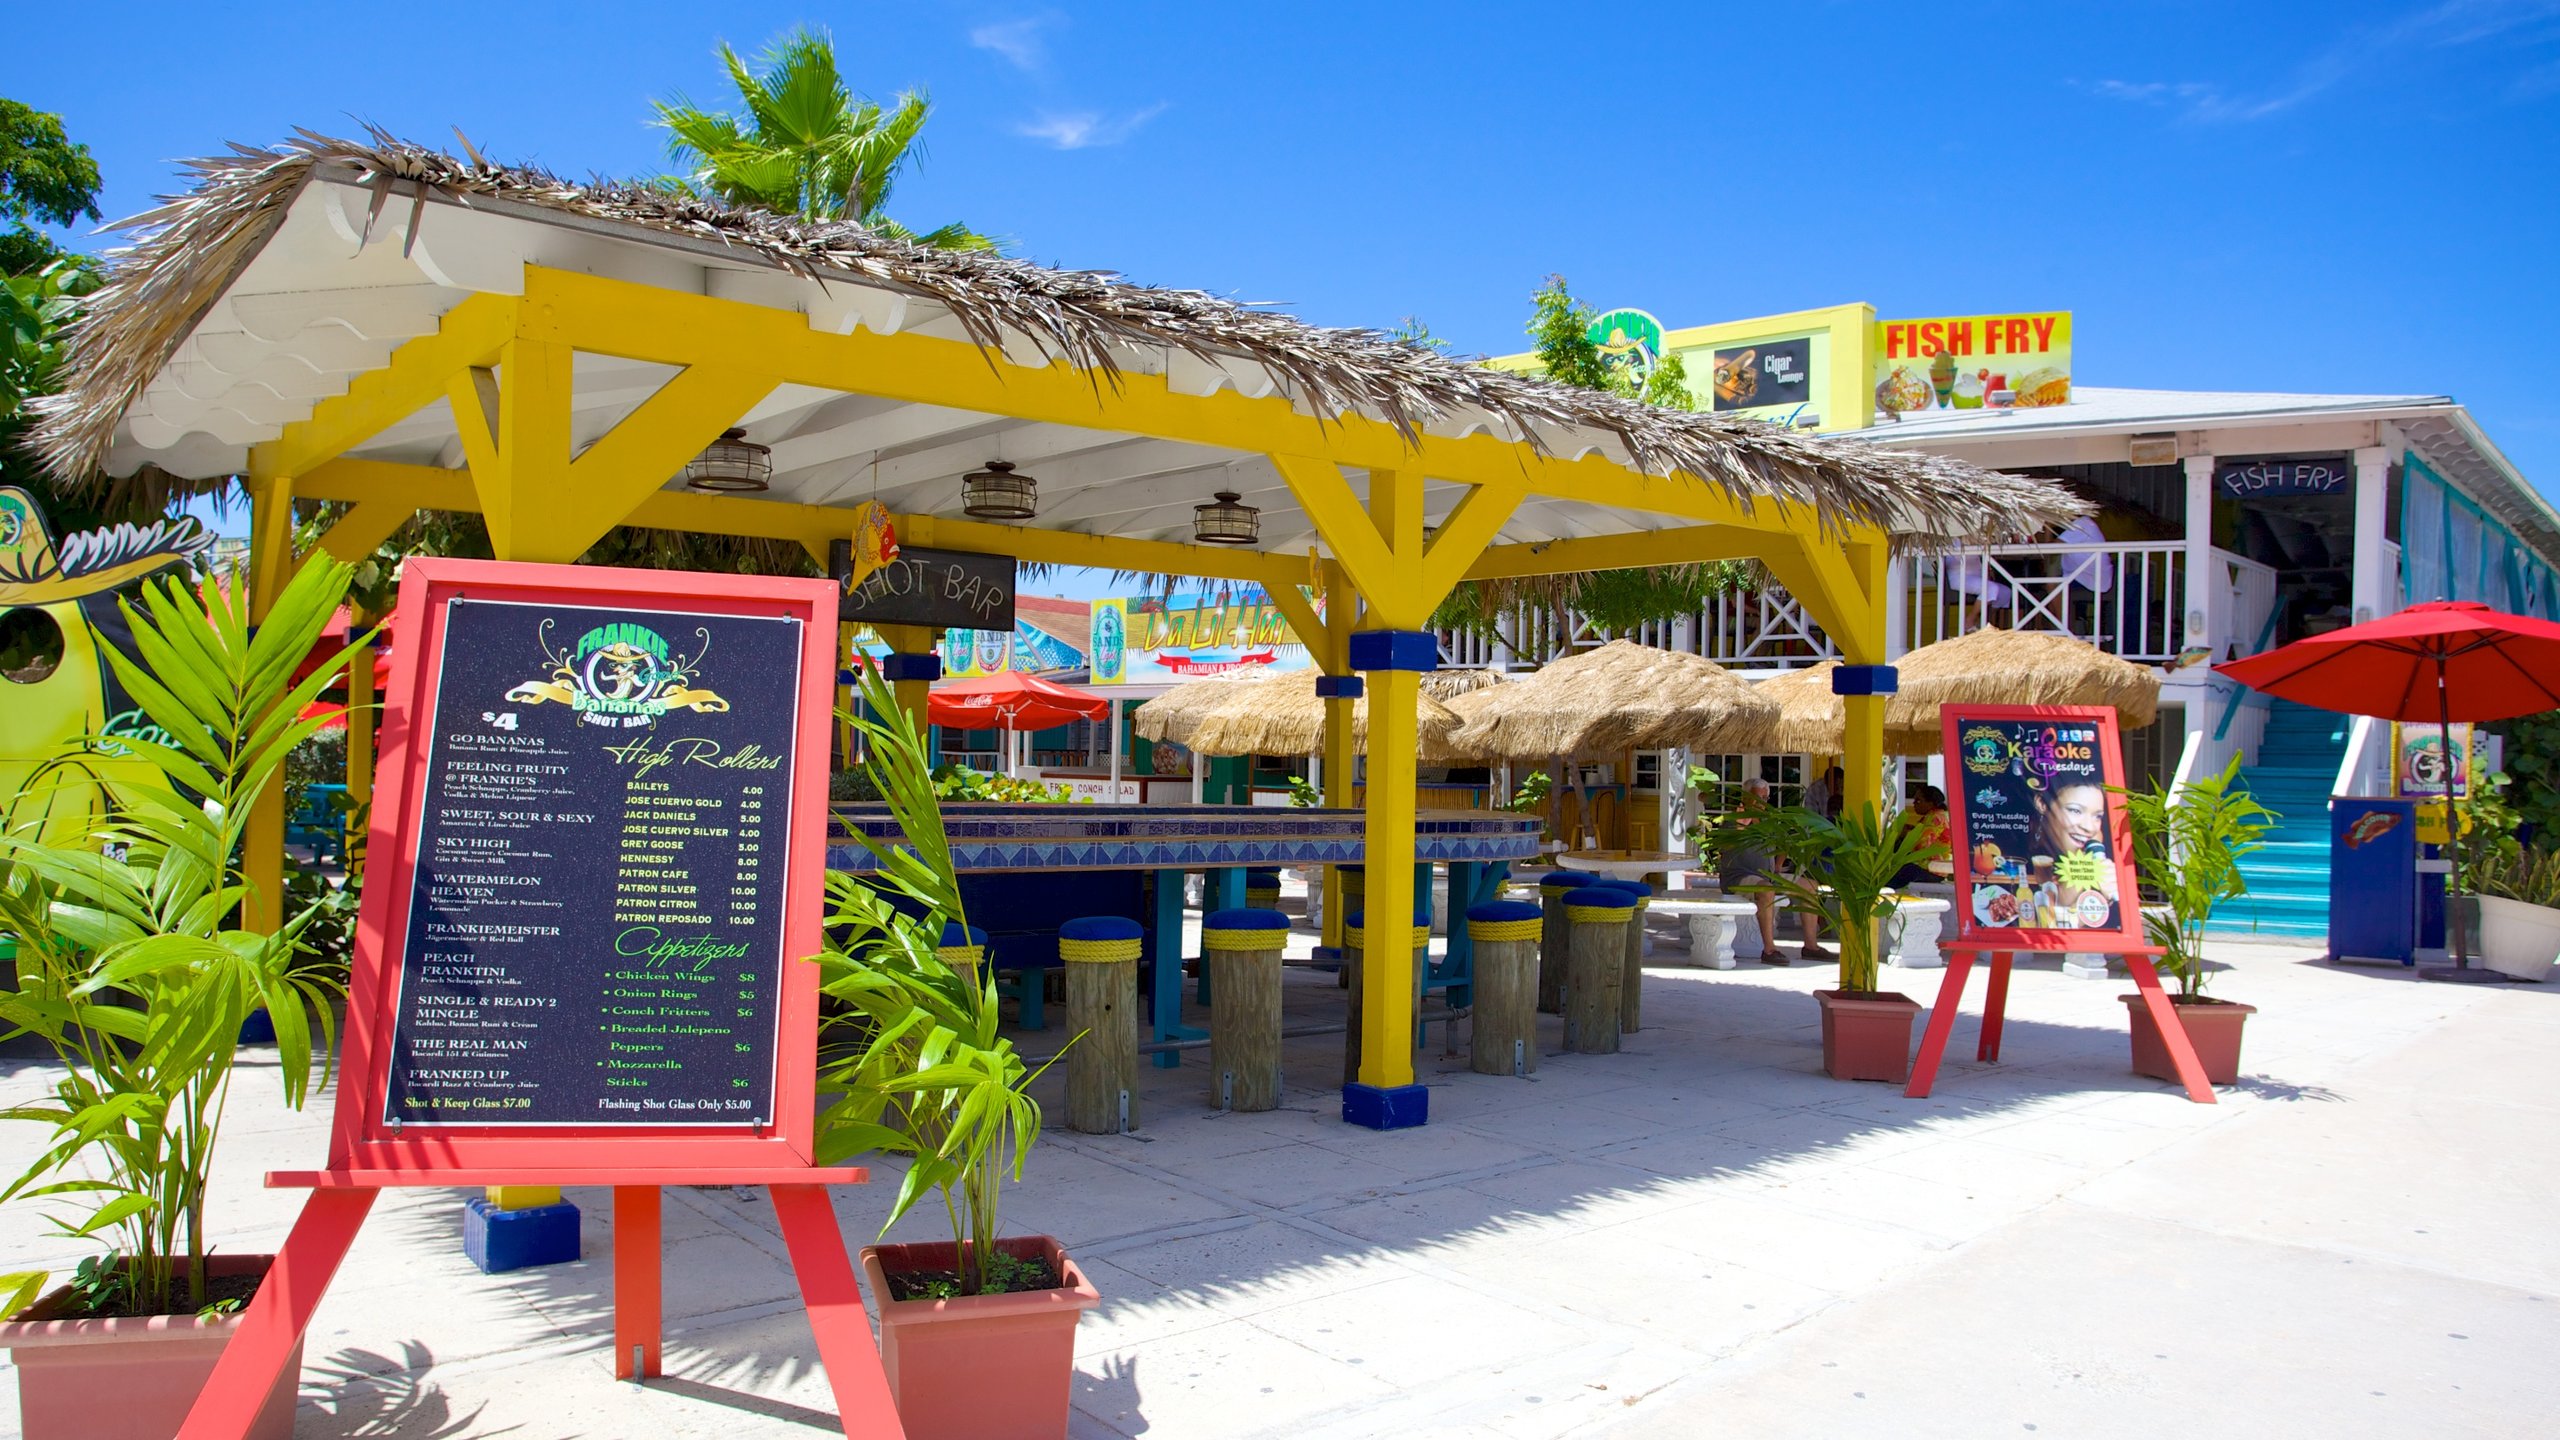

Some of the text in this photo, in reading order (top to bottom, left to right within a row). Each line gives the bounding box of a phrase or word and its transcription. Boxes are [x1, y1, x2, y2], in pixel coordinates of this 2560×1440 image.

[1887, 317, 2056, 359] FISH FRY
[1764, 354, 1793, 375] Cigar
[1777, 370, 1804, 384] Lounge
[2224, 465, 2346, 495] FISH FRY
[841, 558, 1004, 621] SHOT BAR
[1141, 600, 1186, 652] Da
[576, 622, 669, 667] FRANKIE
[1092, 636, 1124, 647] SANDS
[1177, 664, 1218, 674] BAHAMIAN
[481, 712, 520, 730] $4
[582, 711, 652, 728] SHOT BAR
[450, 734, 545, 745] GO BANANAS
[2007, 742, 2092, 760] Karaoke
[602, 736, 782, 779] High Rollers
[447, 761, 568, 774] FEELING FRUITY
[2040, 762, 2096, 775] Tuesdays
[461, 774, 536, 784] FRANKIE'S
[627, 781, 763, 794] BAILEYS 4.00
[1078, 784, 1103, 794] CONCH
[625, 796, 761, 808] JOSE CUERVO GOLD 4.00
[441, 809, 594, 823] SWEET, SOUR & SEXY
[624, 811, 650, 819] JACK
[653, 812, 696, 820] DANIELS
[1972, 812, 2030, 823] Every Tuesday
[623, 825, 760, 837] JOSE CUERVO SILVER 4.00
[437, 838, 511, 847] SKY HIGH
[651, 841, 684, 849] GOOSE
[620, 854, 674, 863] HENNESSY
[619, 869, 659, 877] PATRON
[662, 870, 688, 878] CAFE
[433, 874, 541, 885] WATERMELON
[432, 887, 494, 896] HEAVEN
[618, 884, 756, 895] PATRON SILVER 10.00
[617, 899, 656, 907] PATRON
[660, 900, 696, 908] CITRON
[615, 914, 655, 922] PATRON
[659, 915, 711, 923] REPOSADO
[427, 924, 560, 935] FRANKIEMEISTER
[615, 926, 750, 972] Appetizers
[423, 953, 475, 962] PEACH
[422, 966, 505, 976] FRANKTINI
[615, 971, 755, 982] Chicken Wings $8
[614, 988, 754, 1000] Onion Rings $5
[418, 996, 557, 1006] SINGLE & READY 2
[416, 1009, 479, 1018] MINGLE
[612, 1006, 753, 1017] Conch Fritters $6
[611, 1023, 666, 1033] Breaded
[413, 1039, 528, 1049] THE REAL MAN
[610, 1042, 751, 1052] Peppers $6
[608, 1059, 682, 1068] Mozzarella
[409, 1070, 509, 1079] FRANKED UP
[607, 1078, 748, 1087] Sticks $6
[404, 1097, 531, 1109] Shot & Keep Glass $7.00
[598, 1098, 751, 1111] Flashing Shot Glass Only $5.00
